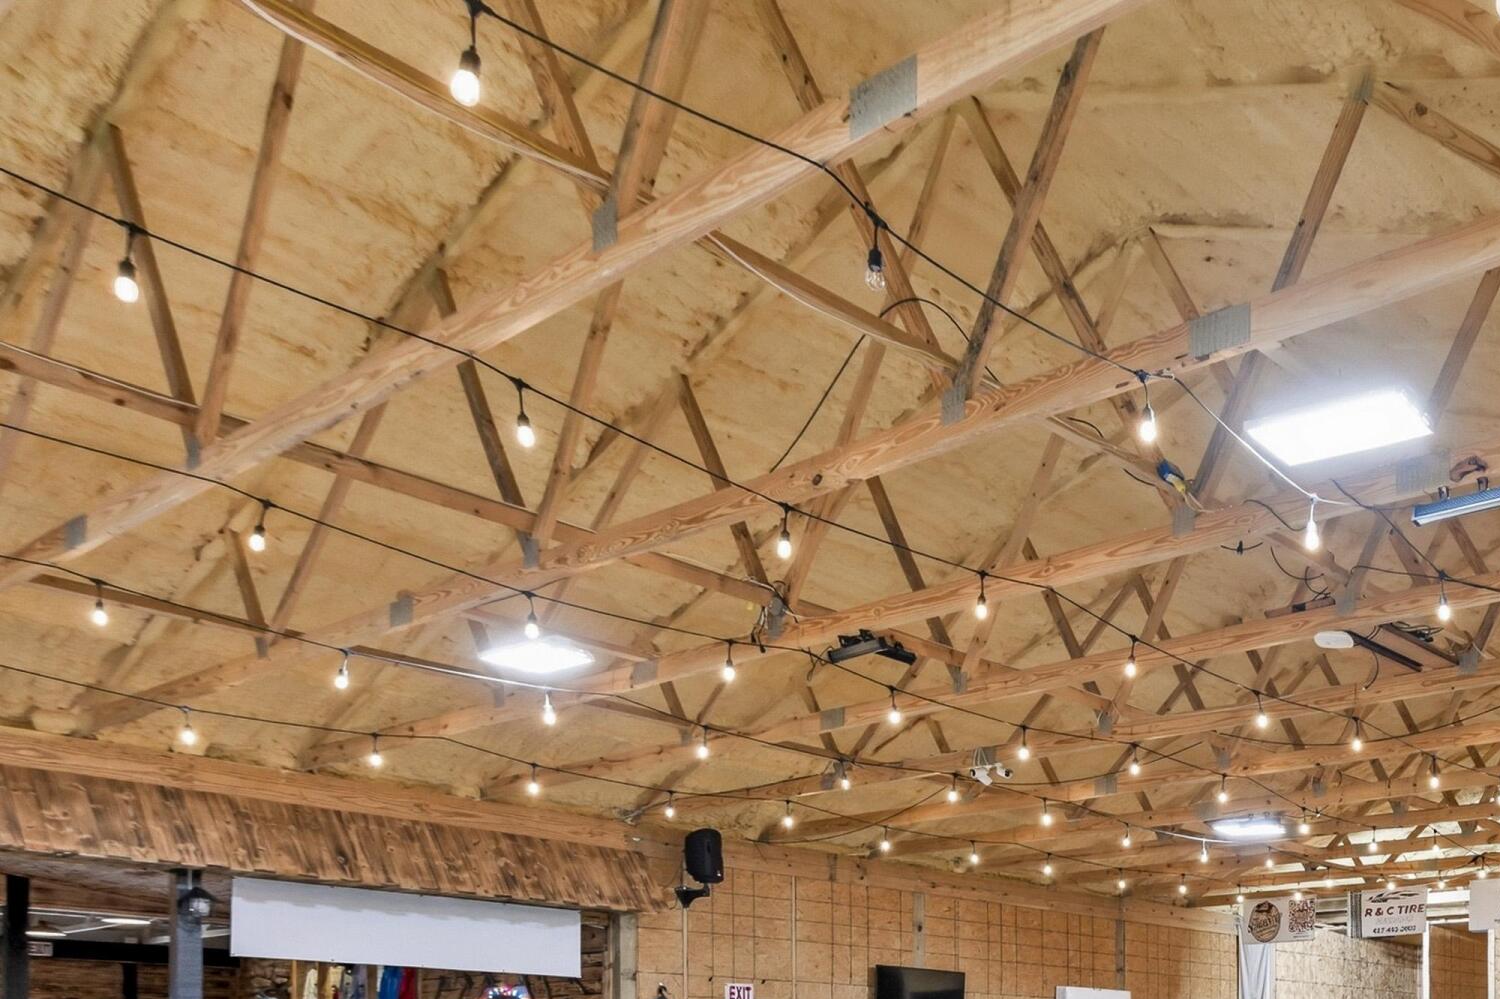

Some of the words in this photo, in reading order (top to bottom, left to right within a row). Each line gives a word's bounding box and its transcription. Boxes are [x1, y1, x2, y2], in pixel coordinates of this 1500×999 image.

[1364, 908, 1373, 917] R
[1374, 907, 1383, 916] &
[1386, 906, 1395, 915] C
[1397, 903, 1425, 914] TIRE
